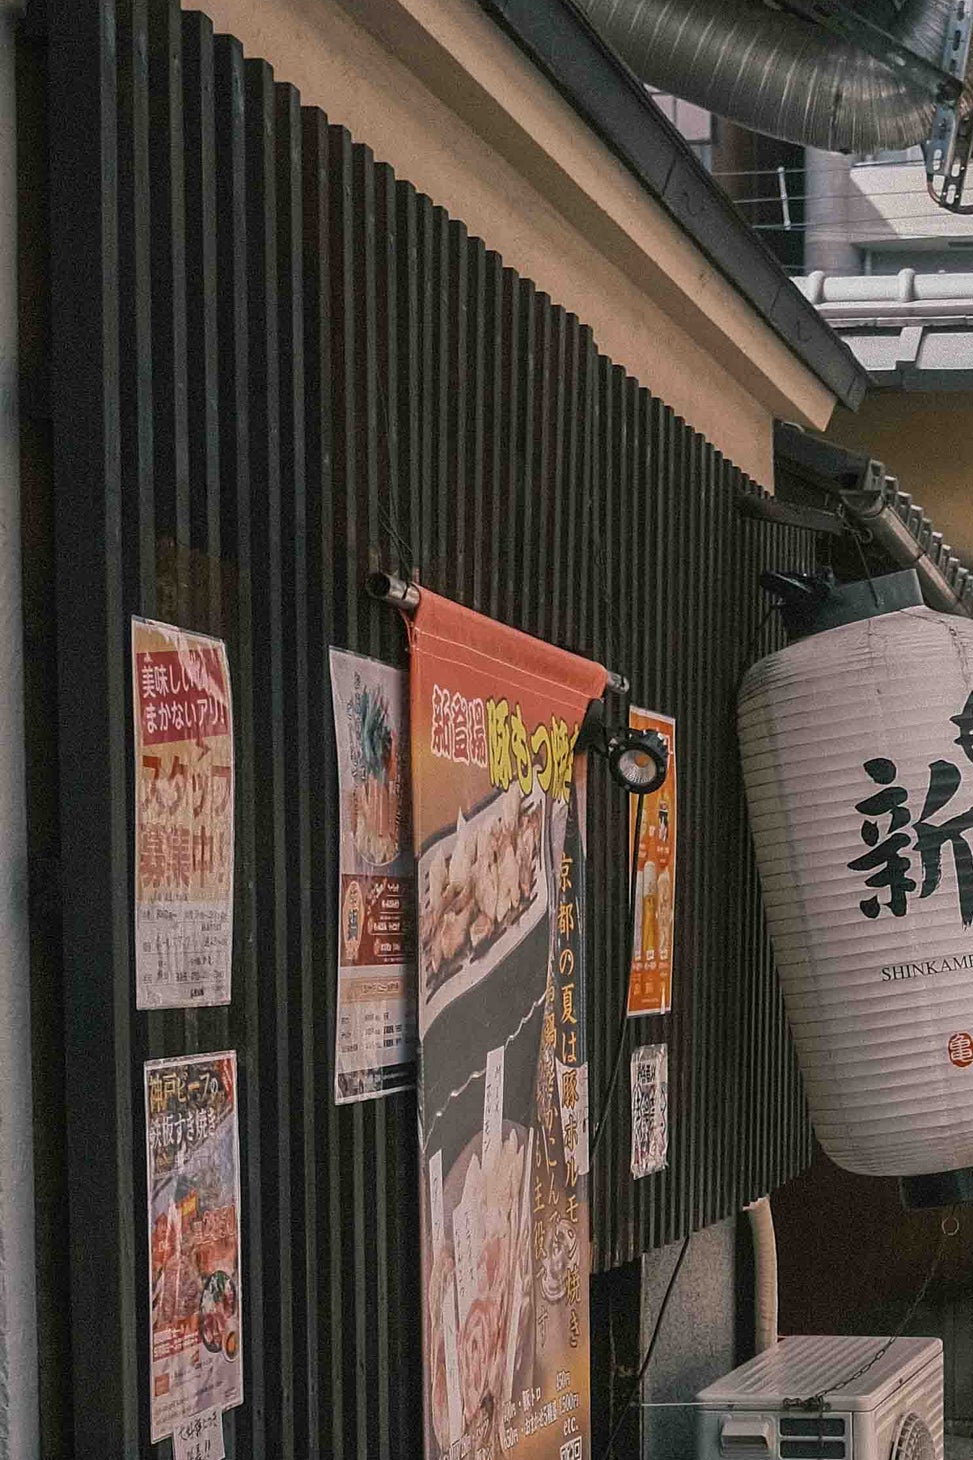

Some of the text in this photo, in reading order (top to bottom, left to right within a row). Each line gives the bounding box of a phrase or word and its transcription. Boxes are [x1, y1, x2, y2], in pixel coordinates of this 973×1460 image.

[430, 684, 488, 768] 新登場
[563, 1416, 579, 1436] etc.
